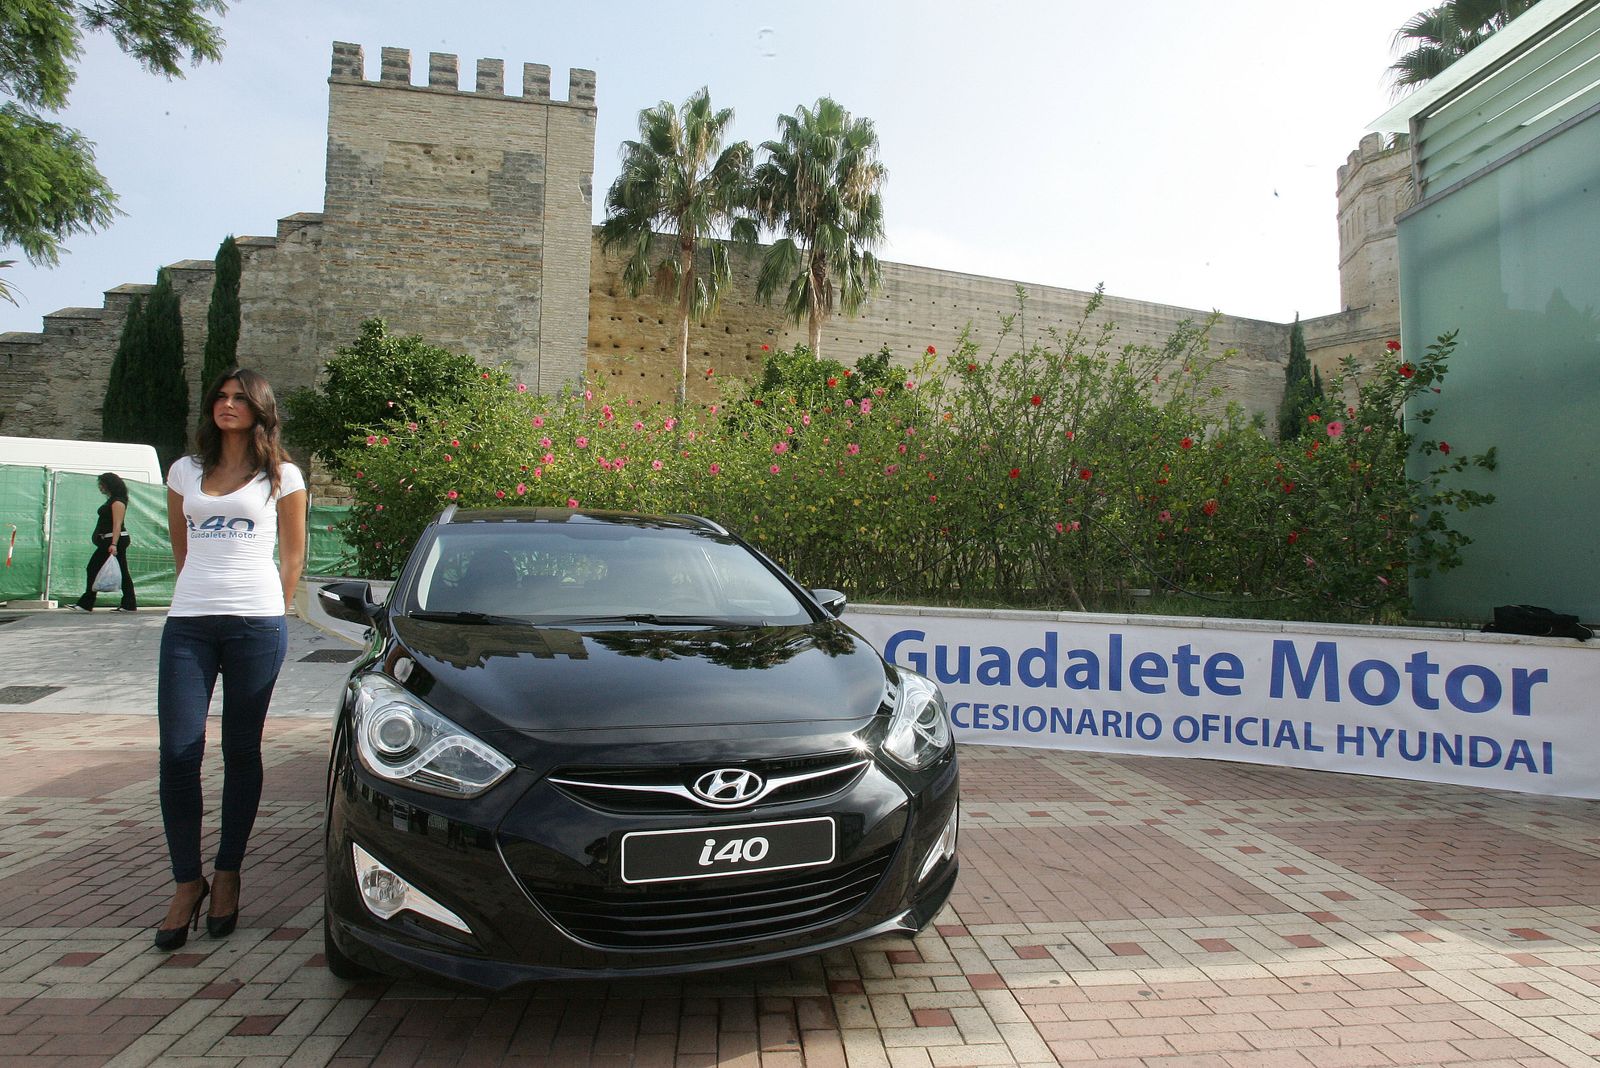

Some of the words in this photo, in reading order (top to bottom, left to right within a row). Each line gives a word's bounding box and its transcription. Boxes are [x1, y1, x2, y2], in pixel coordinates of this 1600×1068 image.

[190, 530, 227, 539] Guadalete
[229, 531, 257, 539] Motor
[883, 629, 1245, 697] Guadalete
[1269, 639, 1548, 717] Motor
[945, 702, 1162, 741] CESIONARIO
[1172, 712, 1324, 753] OFICIAL
[1336, 723, 1553, 775] HYUNDAI
[698, 836, 769, 866] i40
